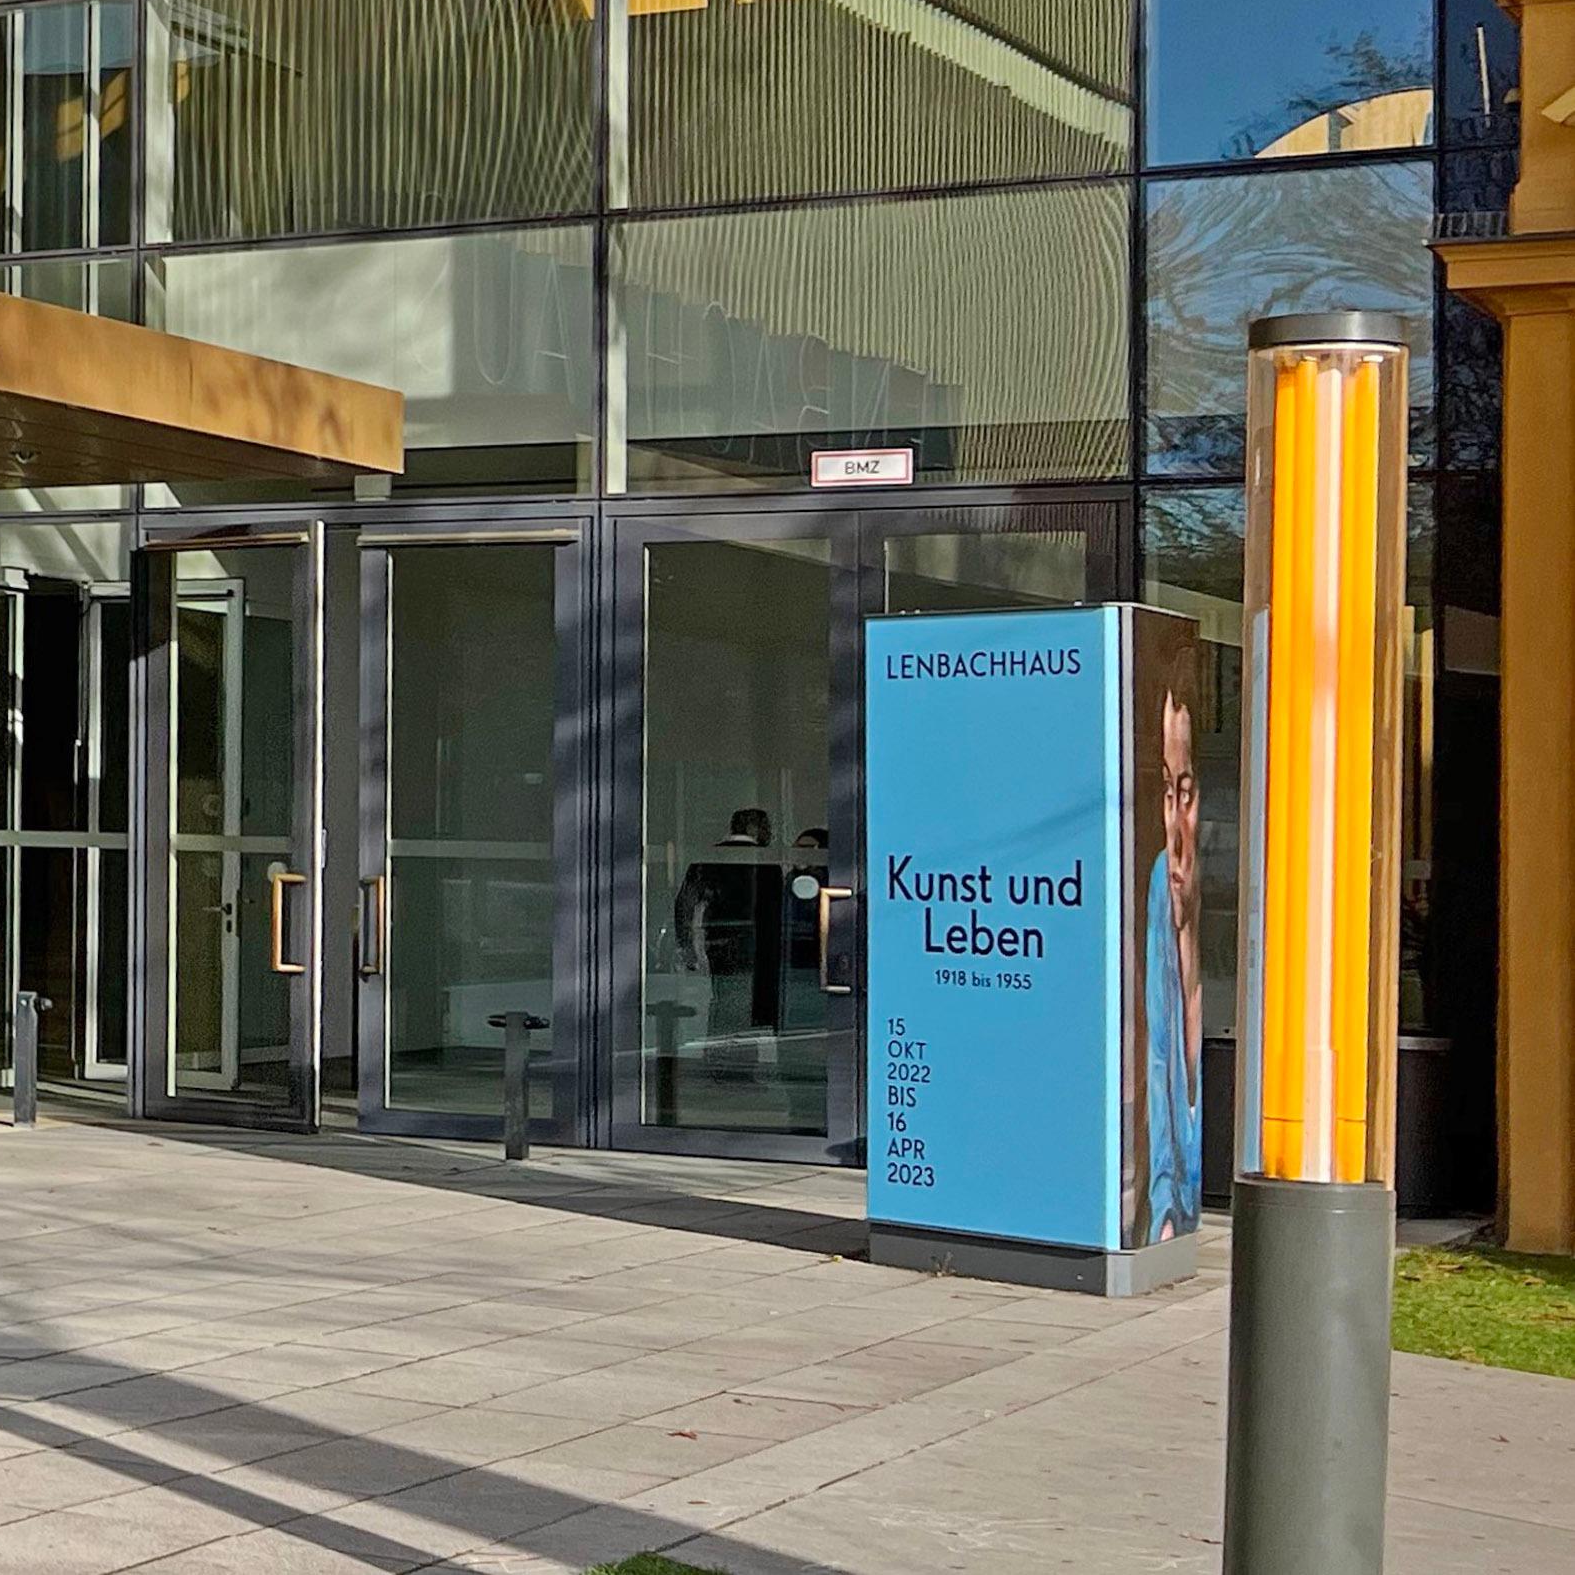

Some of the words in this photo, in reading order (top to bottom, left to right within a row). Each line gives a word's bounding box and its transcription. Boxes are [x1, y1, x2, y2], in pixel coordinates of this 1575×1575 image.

[844, 460, 881, 475] BMZ
[886, 648, 1082, 679] LENBACHHAUS
[888, 855, 993, 904] Kunst
[1008, 859, 1083, 907] und
[924, 906, 1044, 959] Leben
[934, 969, 968, 986] 1918
[972, 971, 992, 988] bis
[996, 973, 1033, 990] 1955
[888, 1018, 906, 1036] 15
[887, 1040, 927, 1060] OKT
[887, 1062, 931, 1084] 2022
[887, 1085, 917, 1107] BIS
[887, 1111, 907, 1132] 16
[887, 1137, 926, 1160] APR
[887, 1162, 935, 1187] 2023
